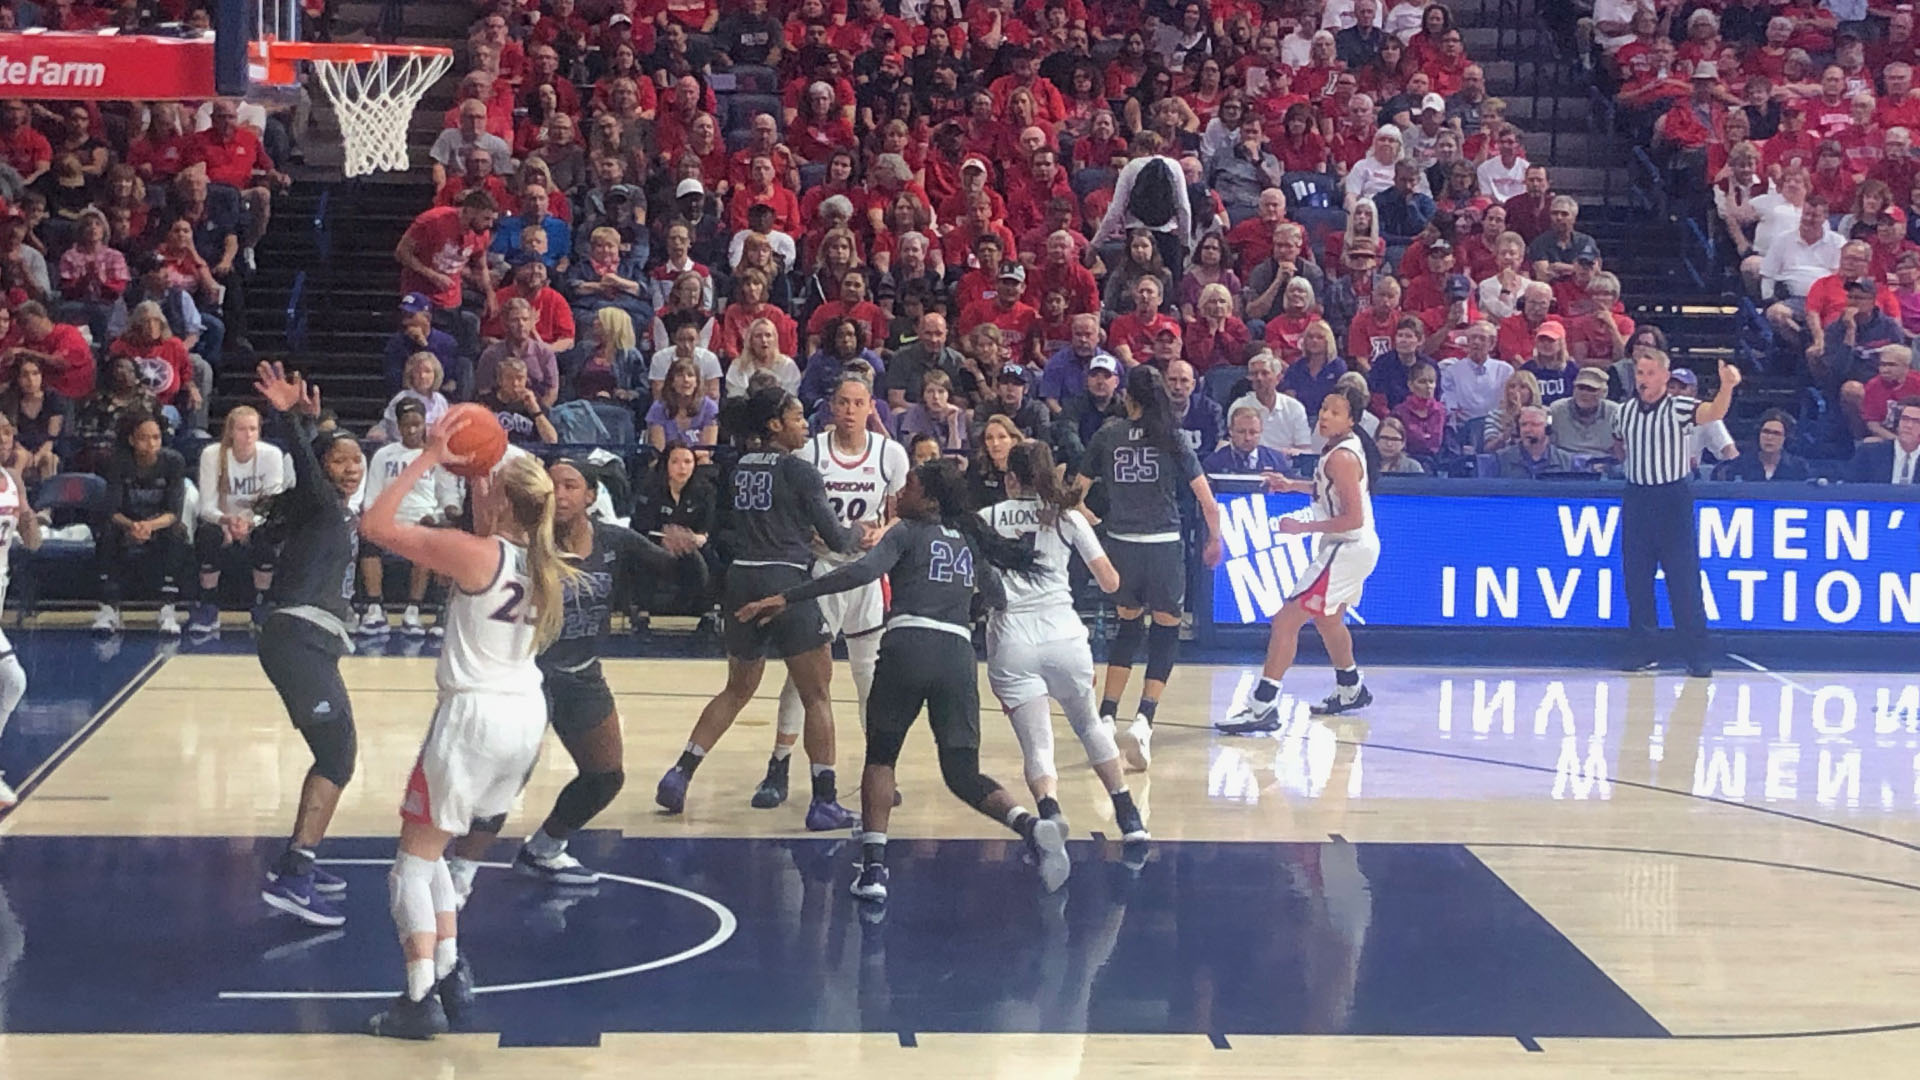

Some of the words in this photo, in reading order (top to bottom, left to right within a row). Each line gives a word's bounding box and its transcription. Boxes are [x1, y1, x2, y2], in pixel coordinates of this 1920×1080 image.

[1538, 378, 1564, 395] TCU
[1114, 447, 1159, 483] 25
[735, 471, 773, 511] 33
[824, 481, 876, 493] ARIZONA
[828, 497, 867, 522] 20
[928, 540, 974, 587] 24
